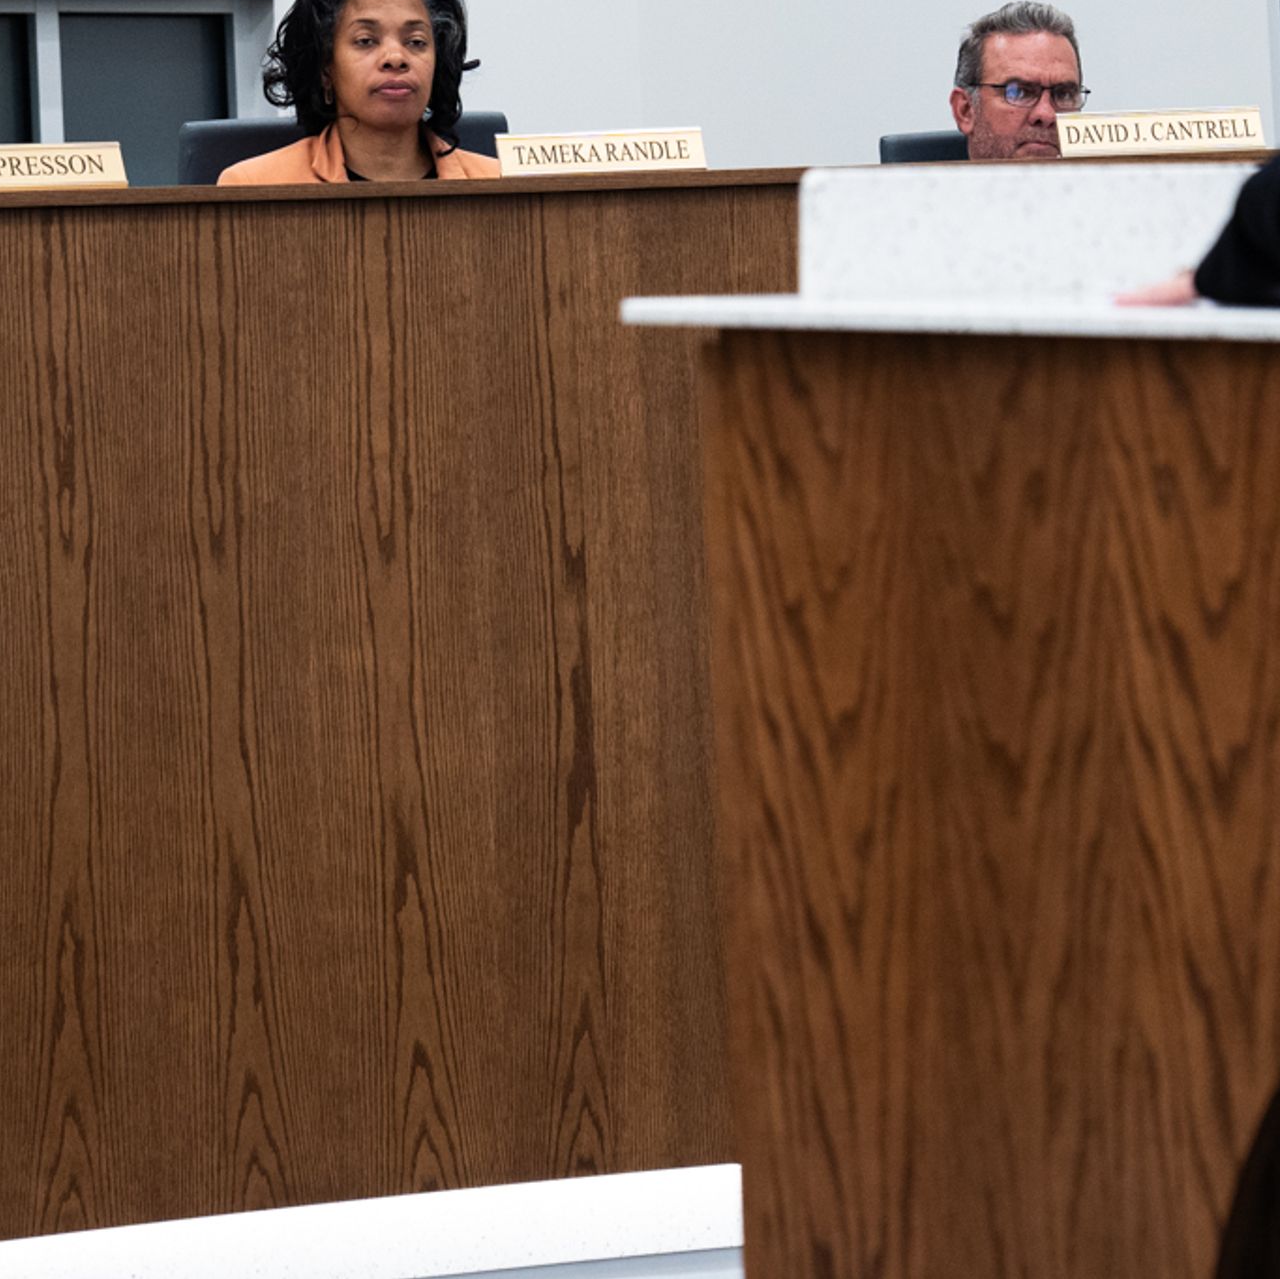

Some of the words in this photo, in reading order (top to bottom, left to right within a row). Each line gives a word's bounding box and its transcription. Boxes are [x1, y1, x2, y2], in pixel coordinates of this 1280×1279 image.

[1066, 123, 1129, 145] DAVID
[1133, 122, 1147, 143] J.
[1151, 118, 1257, 141] CANTRELL
[513, 142, 602, 166] TAMEKA
[605, 139, 690, 162] RANDLE
